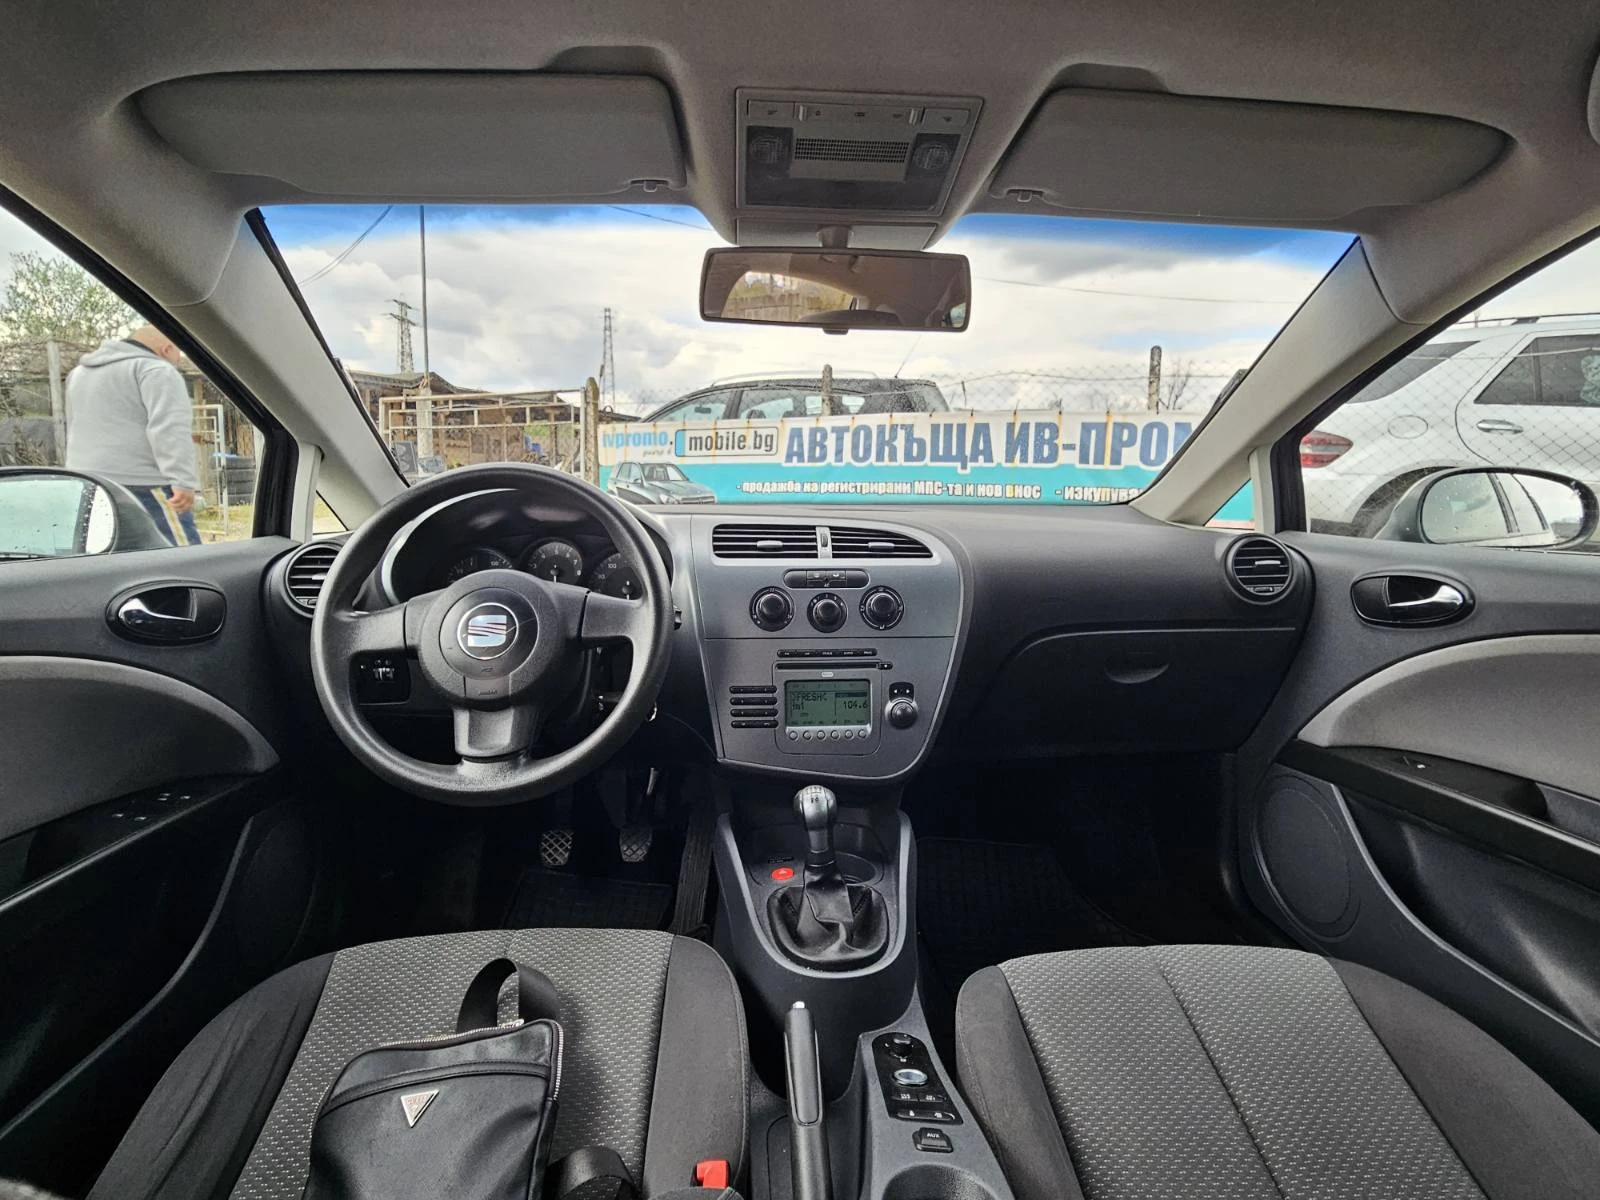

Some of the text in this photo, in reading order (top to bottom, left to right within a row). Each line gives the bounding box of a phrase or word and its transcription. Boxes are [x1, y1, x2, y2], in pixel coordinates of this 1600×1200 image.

[688, 430, 774, 452] mobile.bg
[785, 423, 994, 470] АВТОКЪЩА
[742, 480, 801, 493] продажба
[803, 481, 819, 493] на
[820, 481, 912, 495] регистрирани
